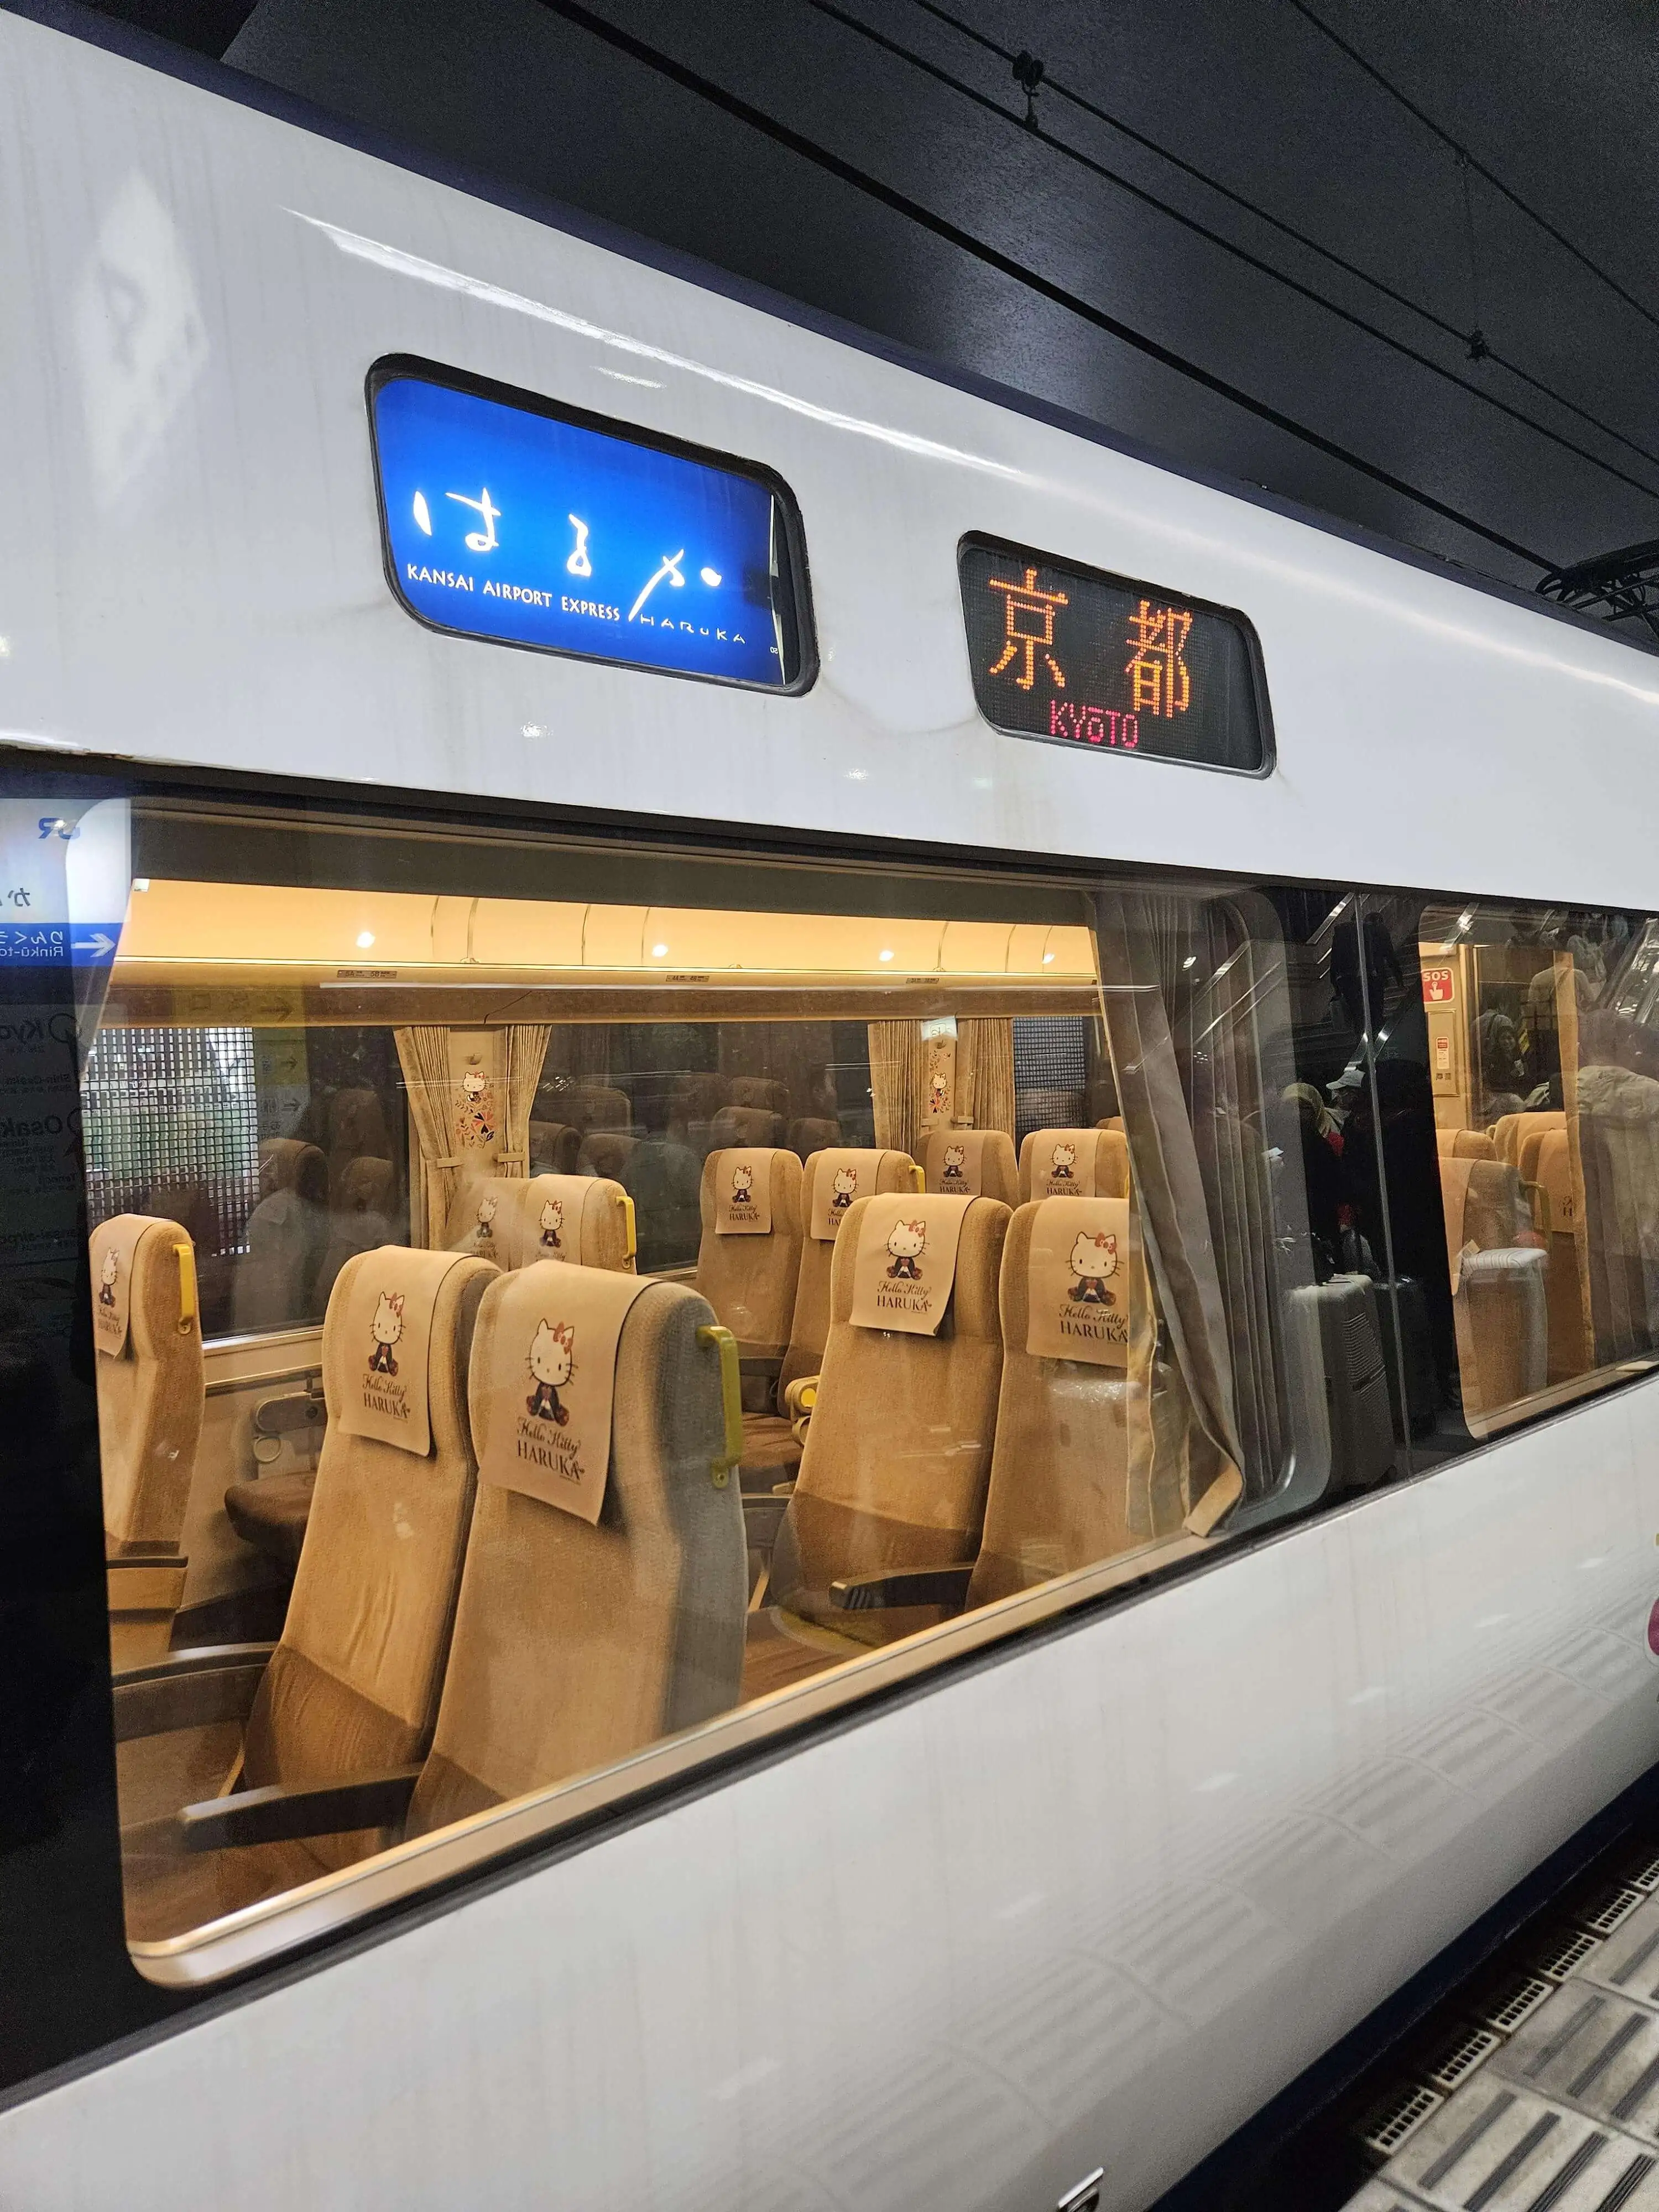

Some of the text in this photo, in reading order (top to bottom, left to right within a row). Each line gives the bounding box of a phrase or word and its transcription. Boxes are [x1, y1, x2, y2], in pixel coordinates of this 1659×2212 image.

[407, 564, 620, 621] KANSAI AIRPORT EXPRESS
[640, 613, 745, 644] HARUKA
[1422, 970, 1449, 982] SOS
[729, 1213, 760, 1221] HARUKA
[877, 1280, 932, 1300] Hello Kitty
[877, 1295, 930, 1312] HARUKA
[1059, 1303, 1129, 1330] Hello Kitty
[1060, 1320, 1128, 1343] HARUKA
[362, 1373, 407, 1404] Hello Kitty
[364, 1392, 409, 1418] HARUKA
[517, 1417, 582, 1460] Hello Kitty
[518, 1439, 583, 1480] HARUKA
